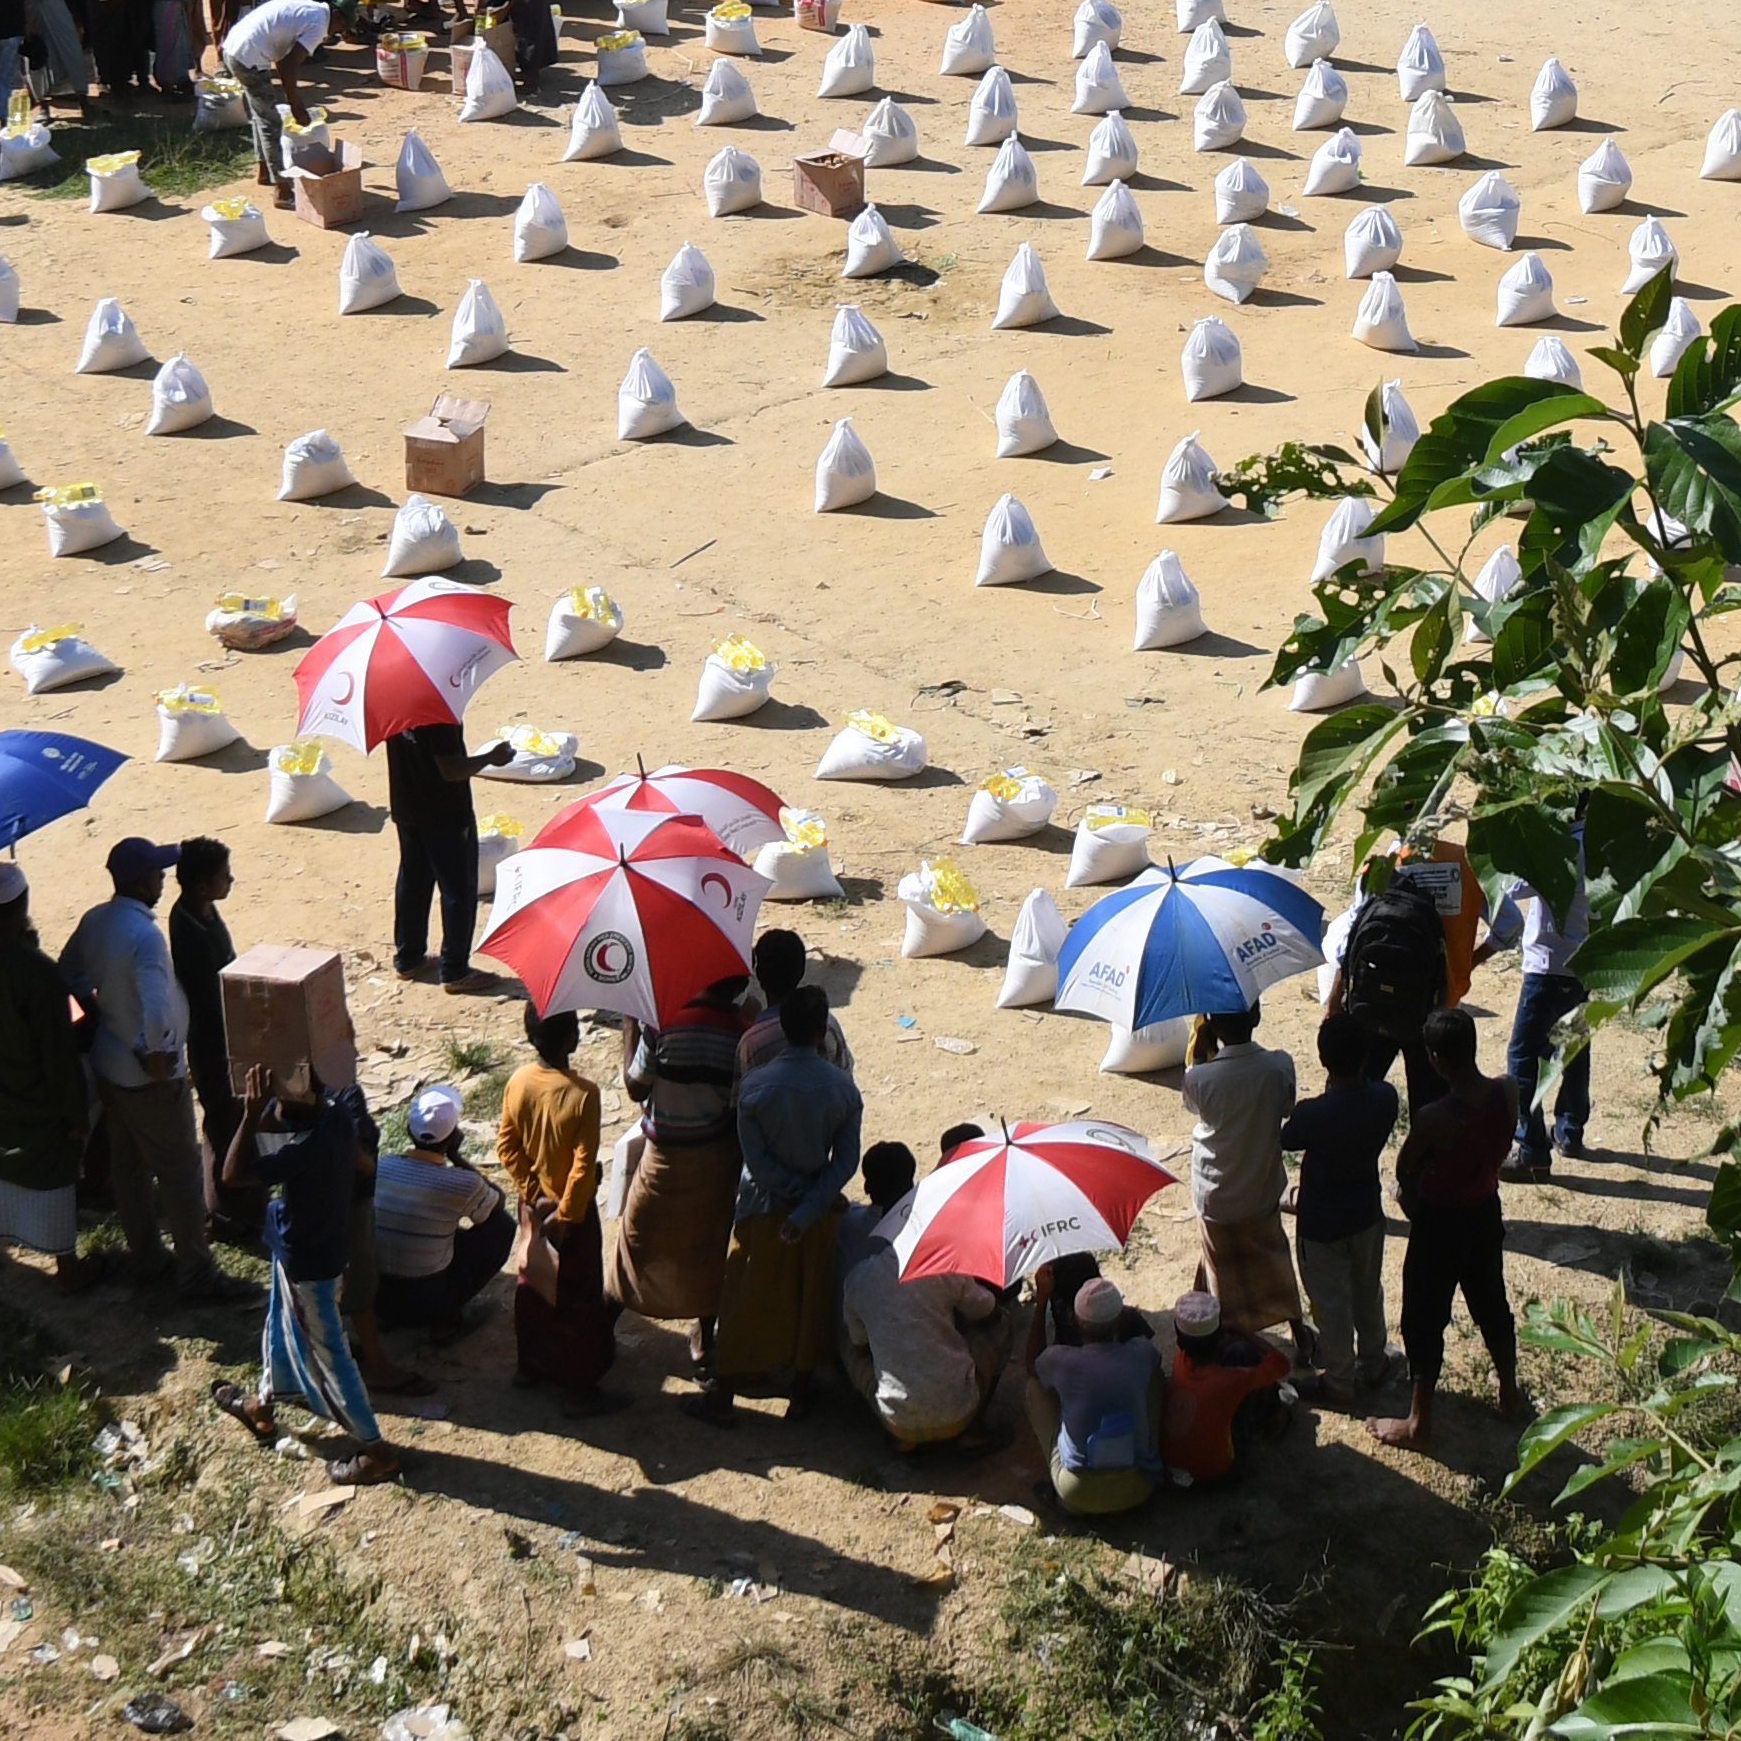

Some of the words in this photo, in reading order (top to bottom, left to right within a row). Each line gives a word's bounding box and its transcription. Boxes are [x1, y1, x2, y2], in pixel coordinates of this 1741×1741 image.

[1236, 932, 1277, 963] AFAD
[1089, 961, 1126, 988] AFAD
[1041, 1216, 1081, 1238] IFRC
